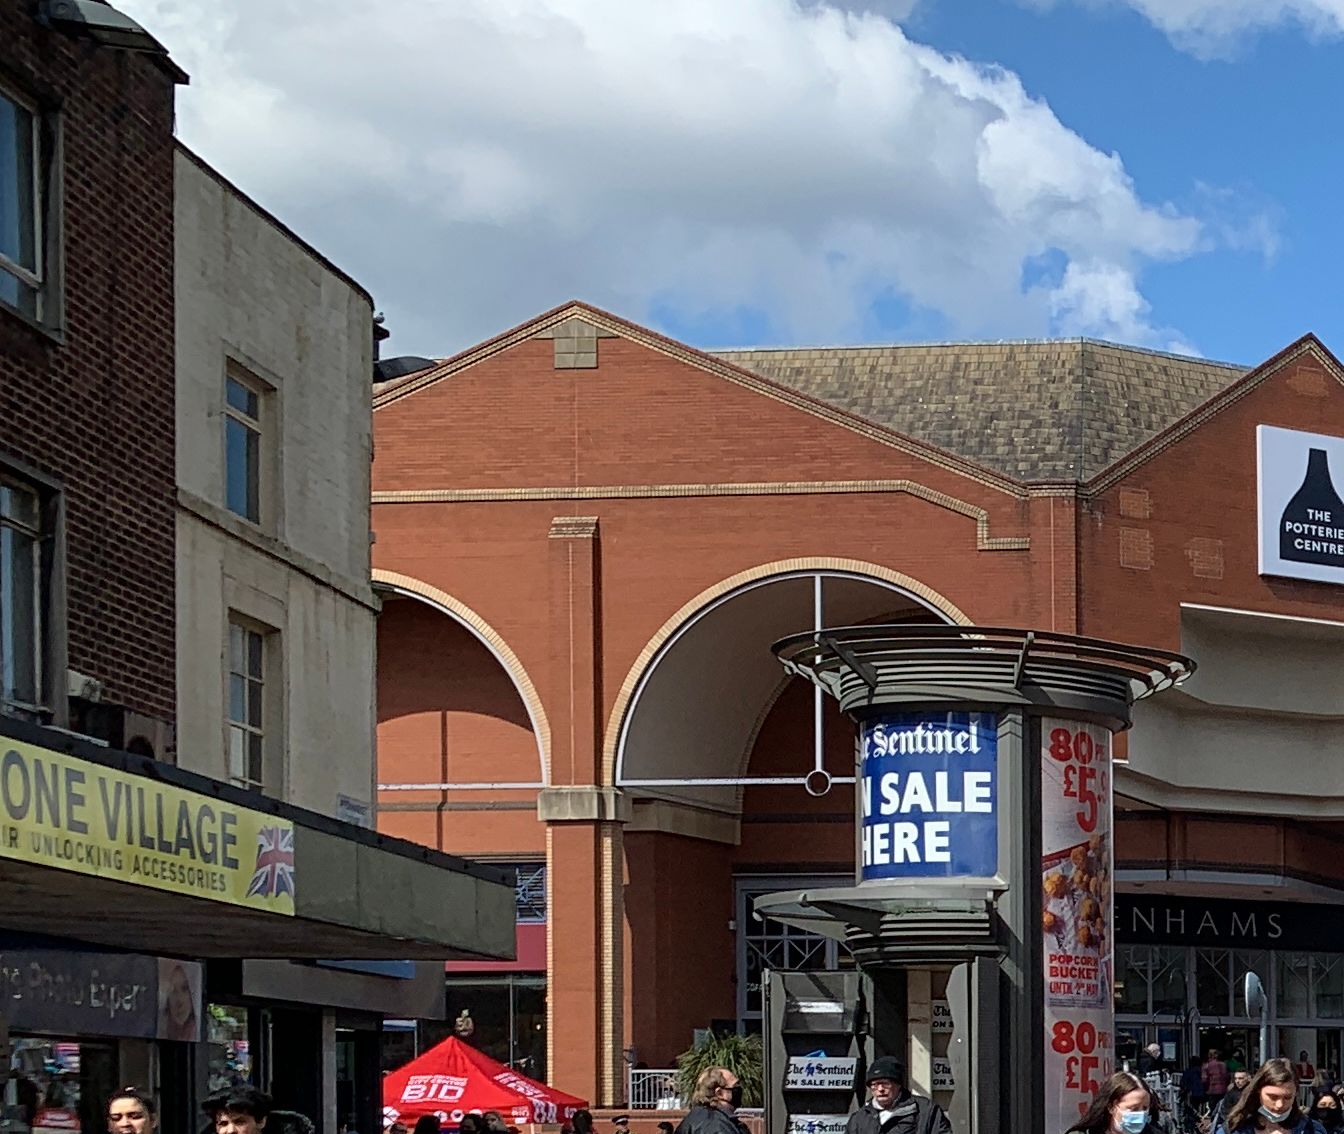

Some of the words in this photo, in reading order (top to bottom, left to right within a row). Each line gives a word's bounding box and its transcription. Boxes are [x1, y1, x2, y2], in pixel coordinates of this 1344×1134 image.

[1307, 508, 1332, 523] THE
[1294, 538, 1344, 555] CENTRE
[872, 720, 981, 758] Sentinel
[1049, 728, 1093, 765] 80
[880, 771, 992, 815] SALE
[2, 749, 89, 835] ONE
[98, 775, 239, 870] VILLAGE
[862, 821, 951, 867] HERE
[31, 831, 123, 871] UNLOCKING
[132, 854, 227, 892] ACCESSORIES
[1049, 954, 1098, 966] POPCORN
[1049, 966, 1099, 980] BUCKET
[1051, 1020, 1096, 1055] 80
[815, 1063, 854, 1075] Sentinel
[401, 1084, 465, 1101] BID
[800, 1079, 825, 1087] SALE
